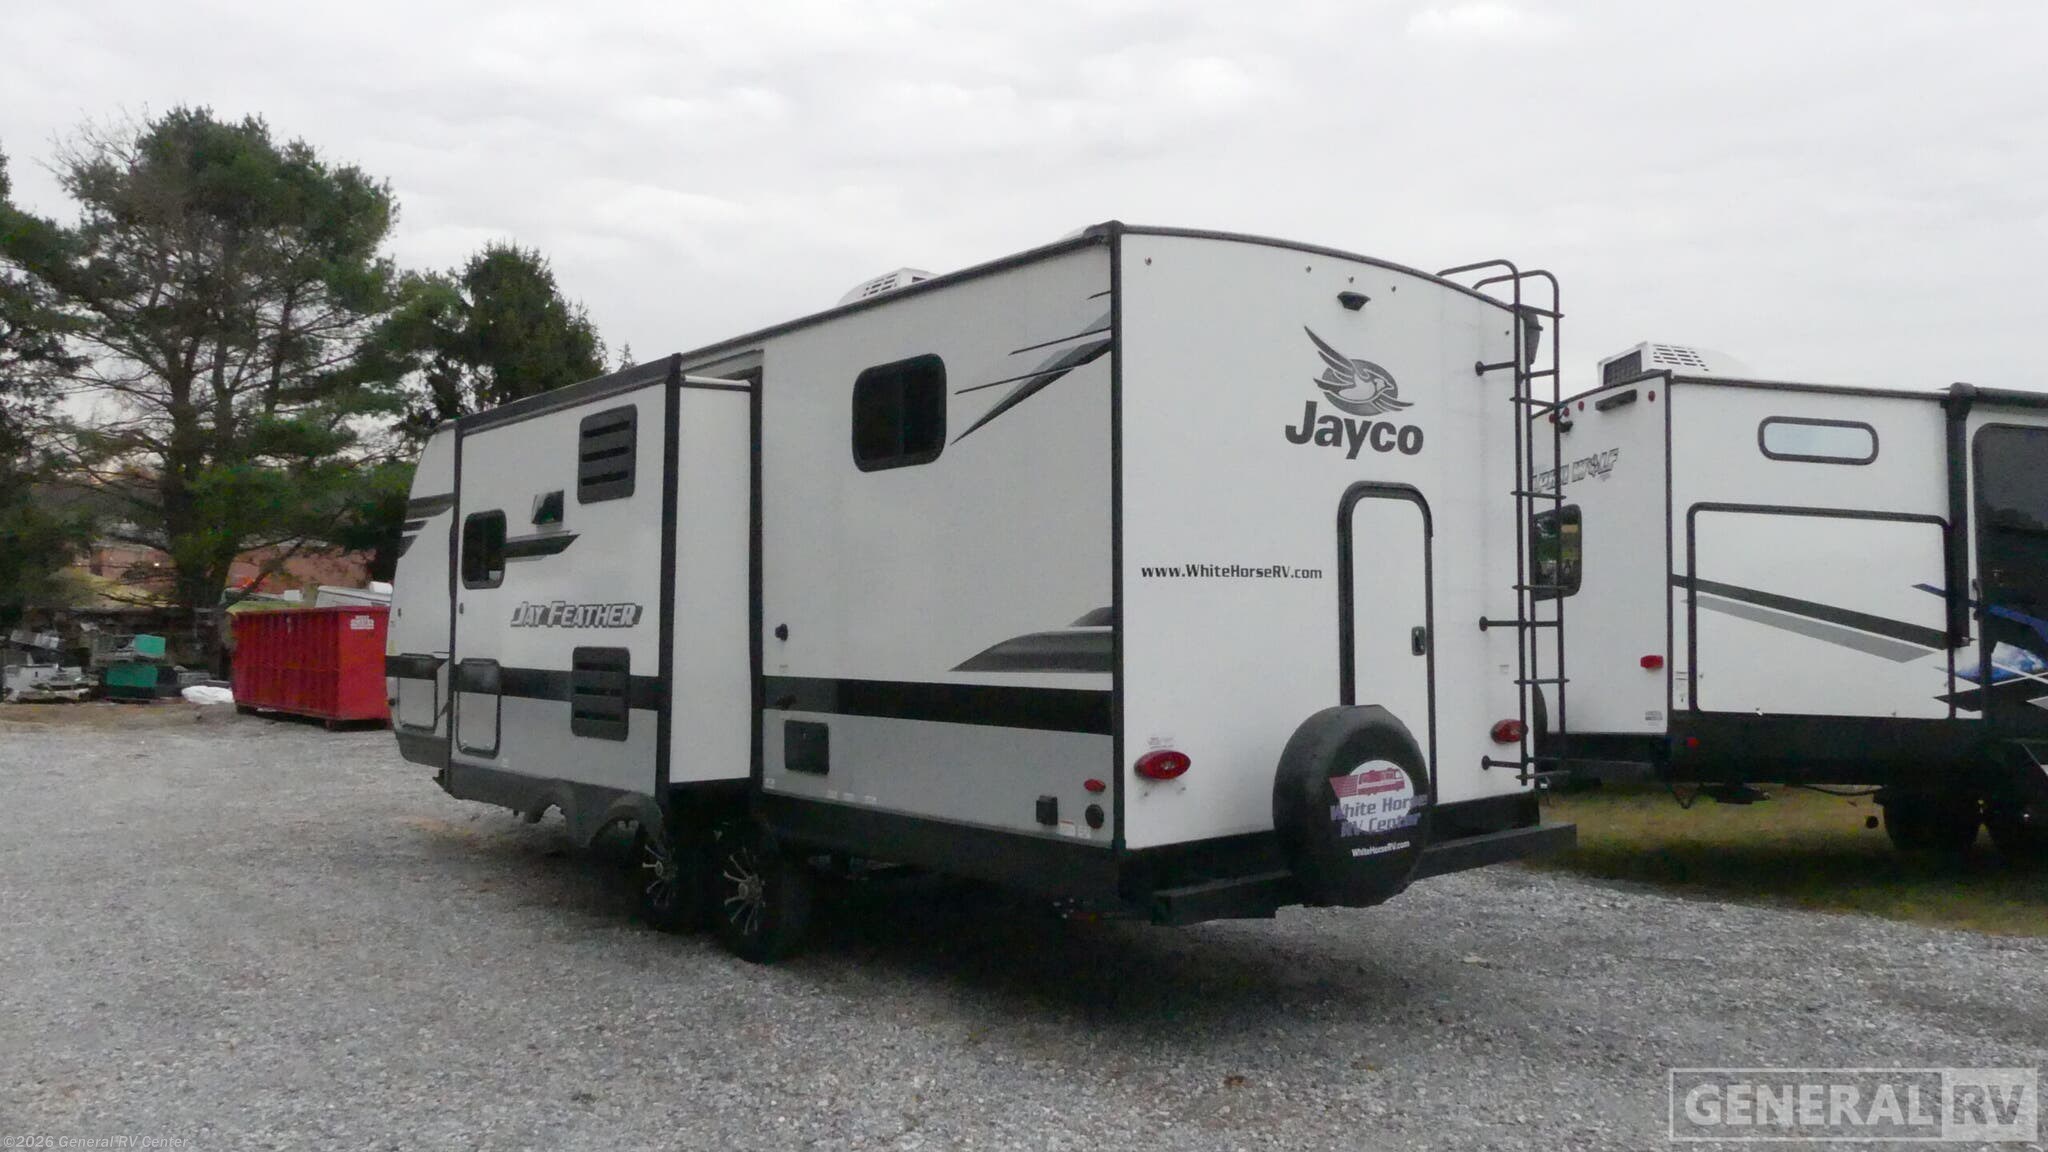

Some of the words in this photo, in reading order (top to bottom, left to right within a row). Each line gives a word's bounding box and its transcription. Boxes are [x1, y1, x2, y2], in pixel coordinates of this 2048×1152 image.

[1285, 400, 1424, 460] Jayco
[1141, 564, 1323, 579] www.WhiteHorseRV.com
[510, 600, 549, 628] JAY
[546, 600, 643, 628] FEATHER
